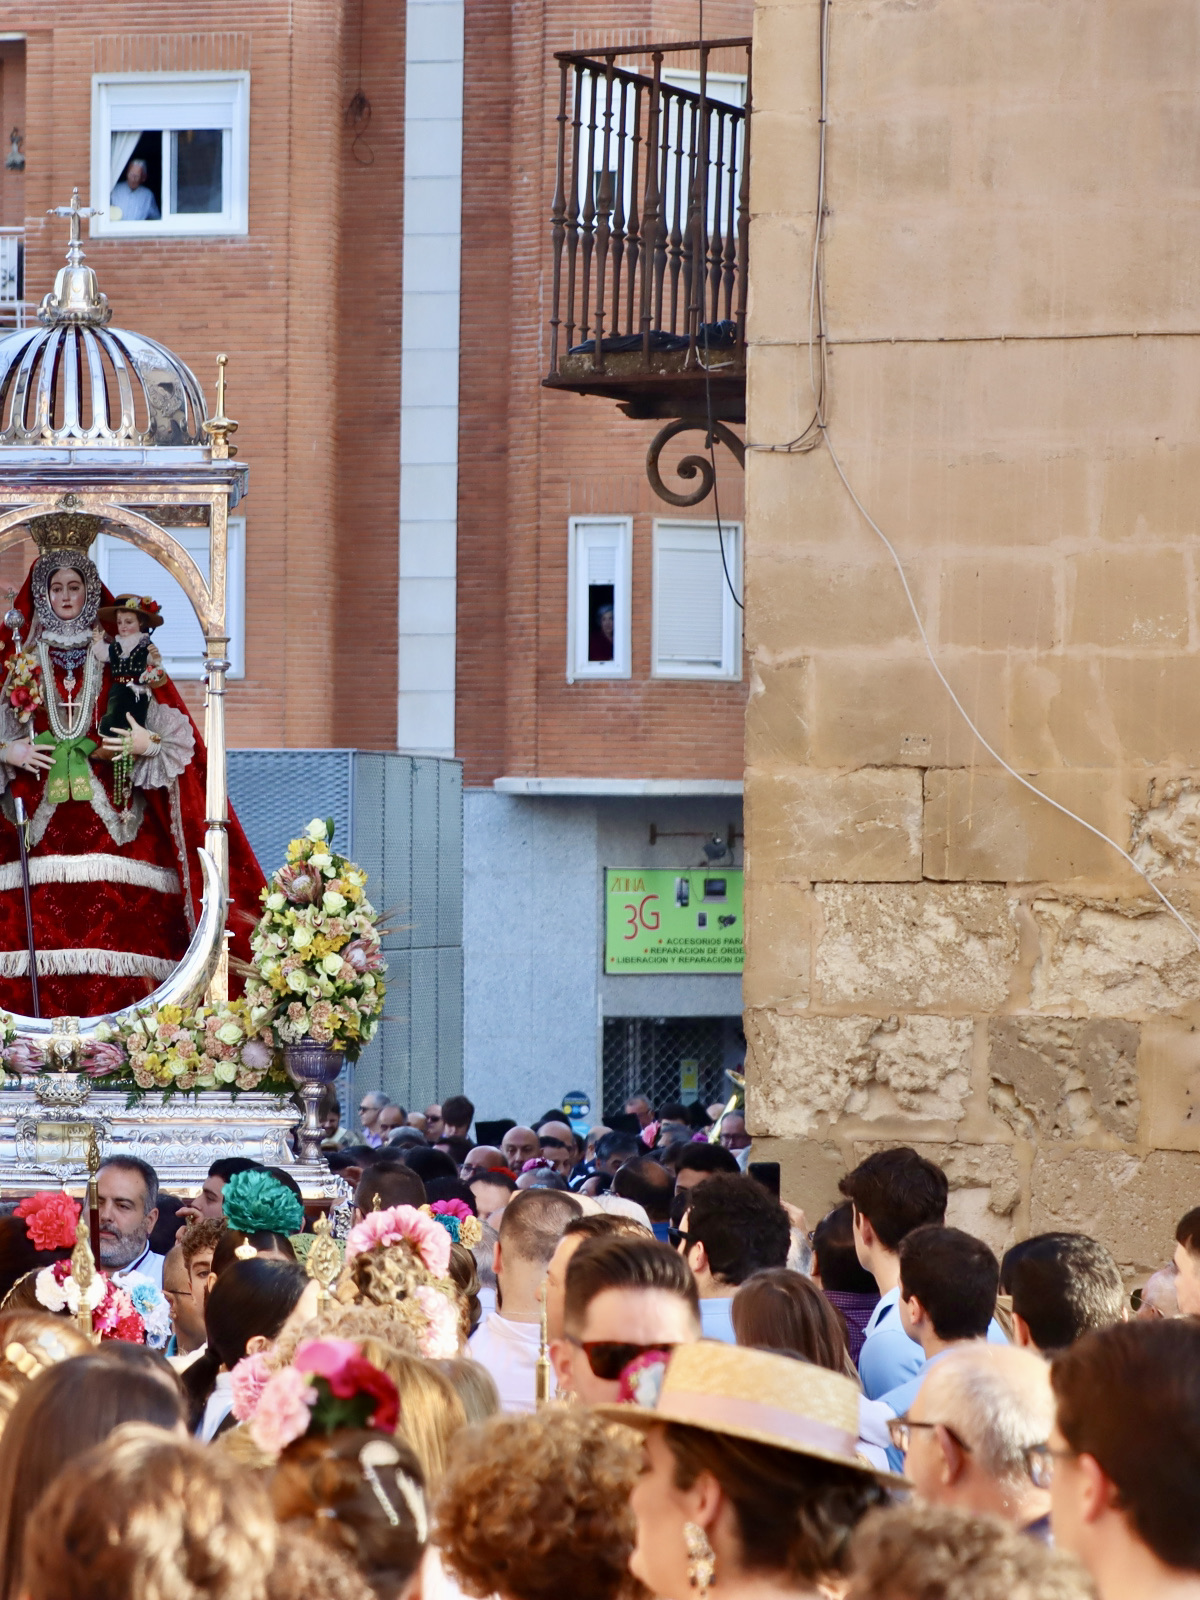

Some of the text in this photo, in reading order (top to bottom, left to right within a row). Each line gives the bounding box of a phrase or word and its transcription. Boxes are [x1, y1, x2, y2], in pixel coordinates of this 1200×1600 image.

[623, 894, 660, 940] 3G
[650, 946, 705, 954] REPARACION
[707, 946, 718, 954] DE
[679, 956, 732, 964] REPARACION
